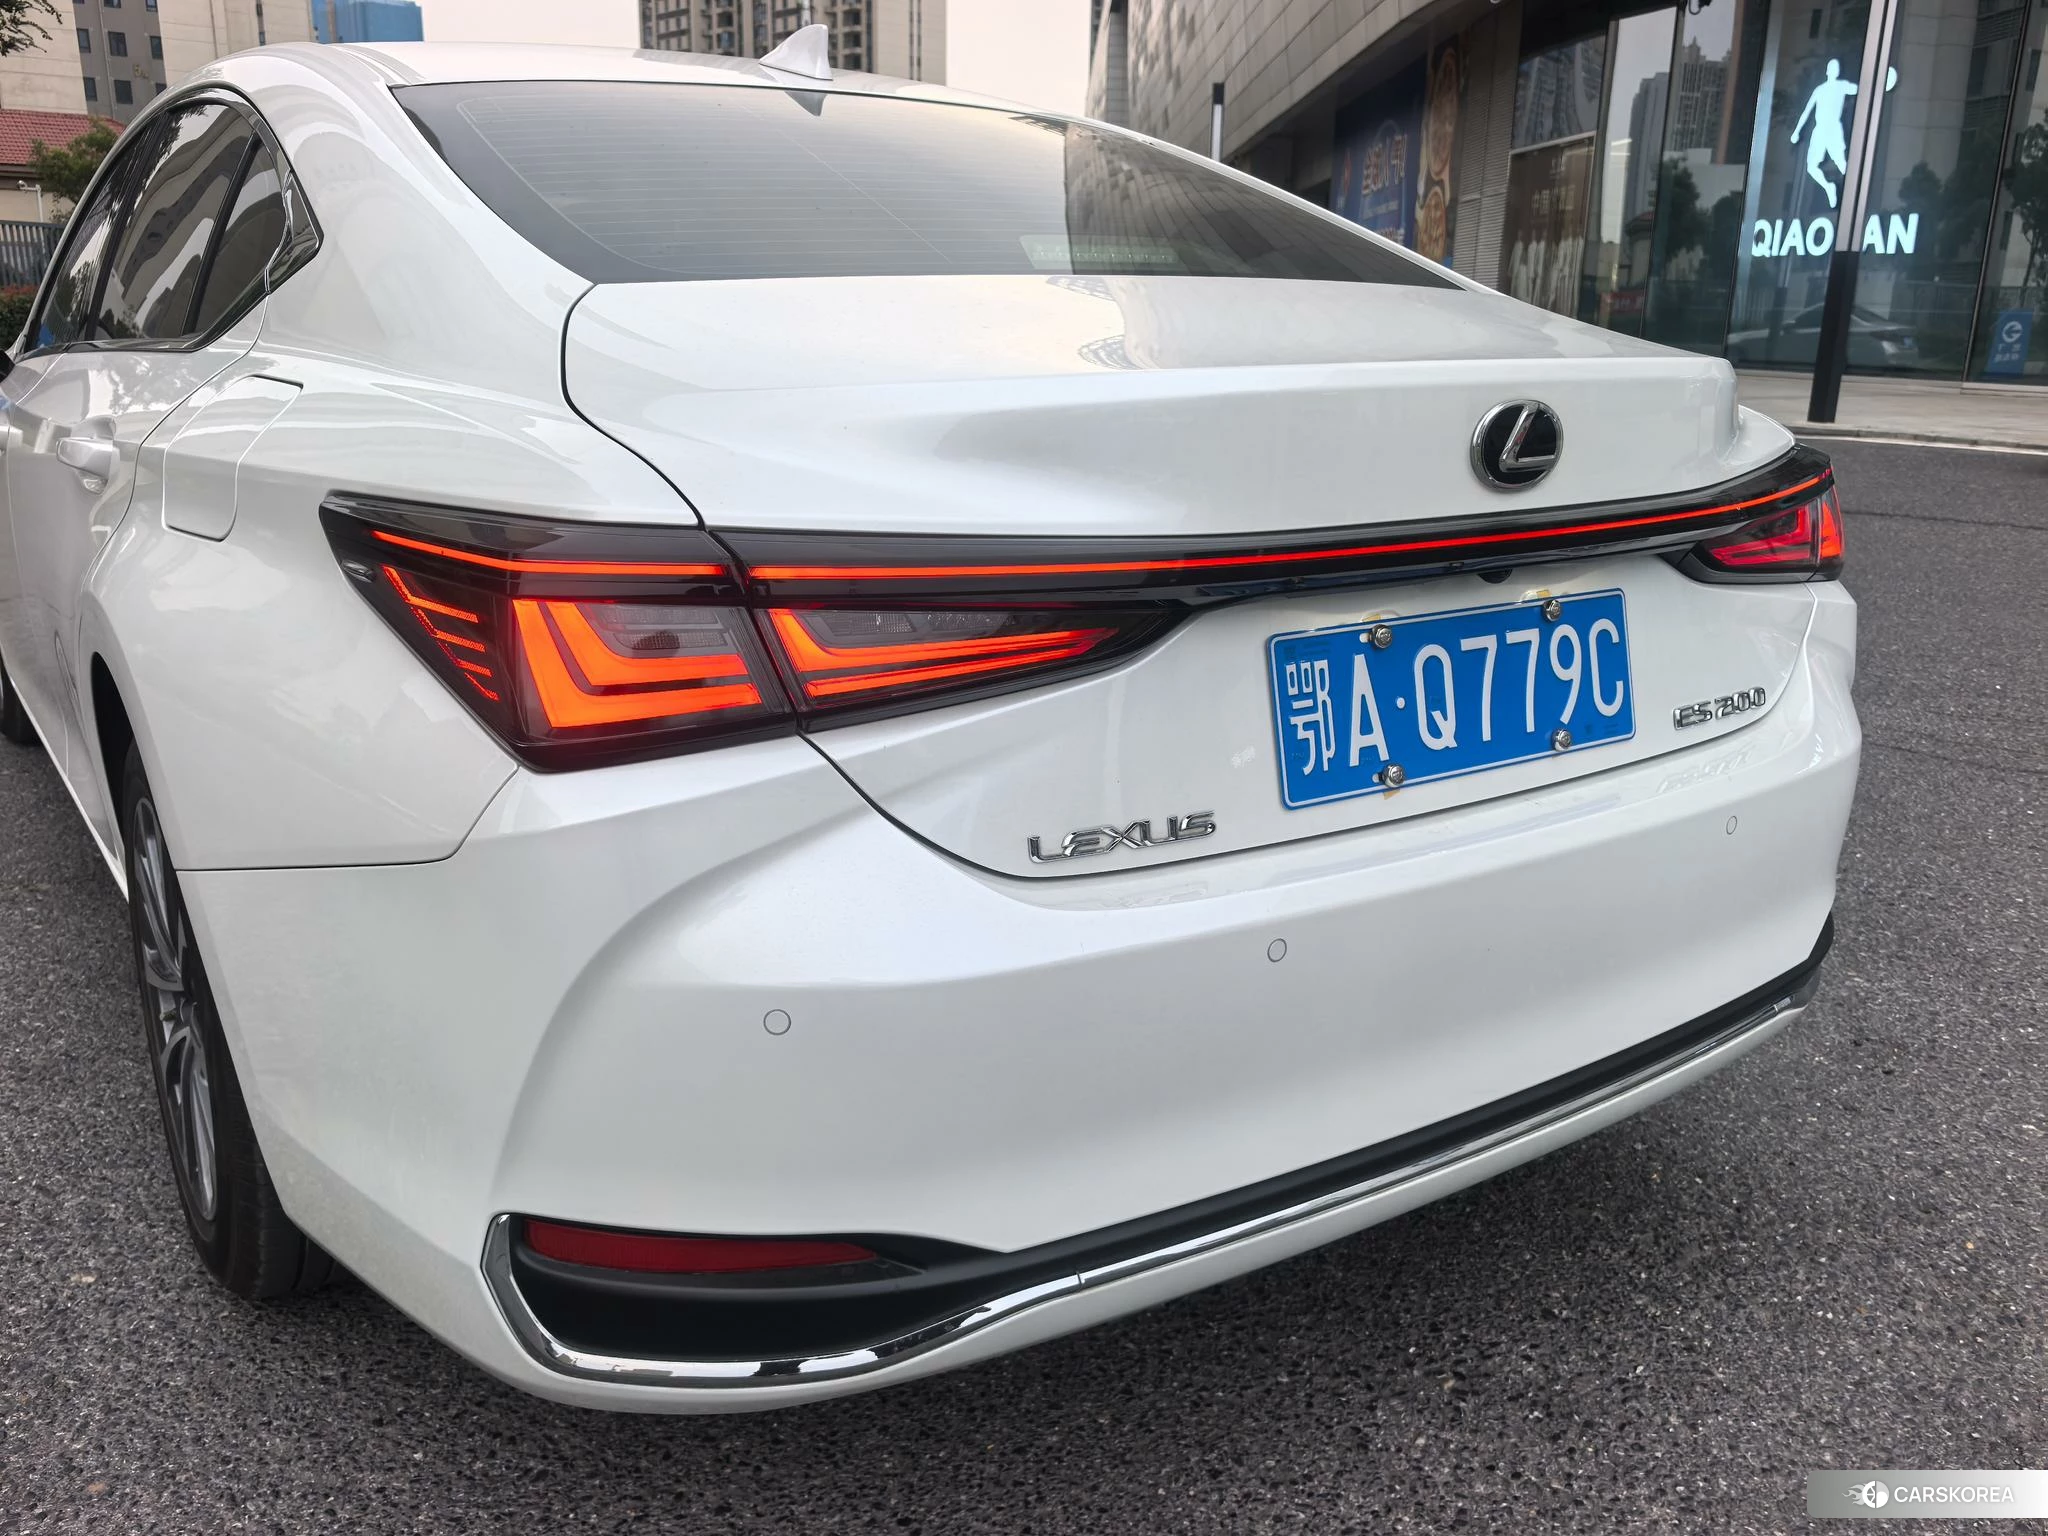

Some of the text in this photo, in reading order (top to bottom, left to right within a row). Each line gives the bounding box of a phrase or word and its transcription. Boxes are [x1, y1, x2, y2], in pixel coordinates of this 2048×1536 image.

[1752, 213, 1919, 257] QIAOAN
[1673, 687, 1766, 730] ES 200
[1027, 810, 1217, 864] LEXUS
